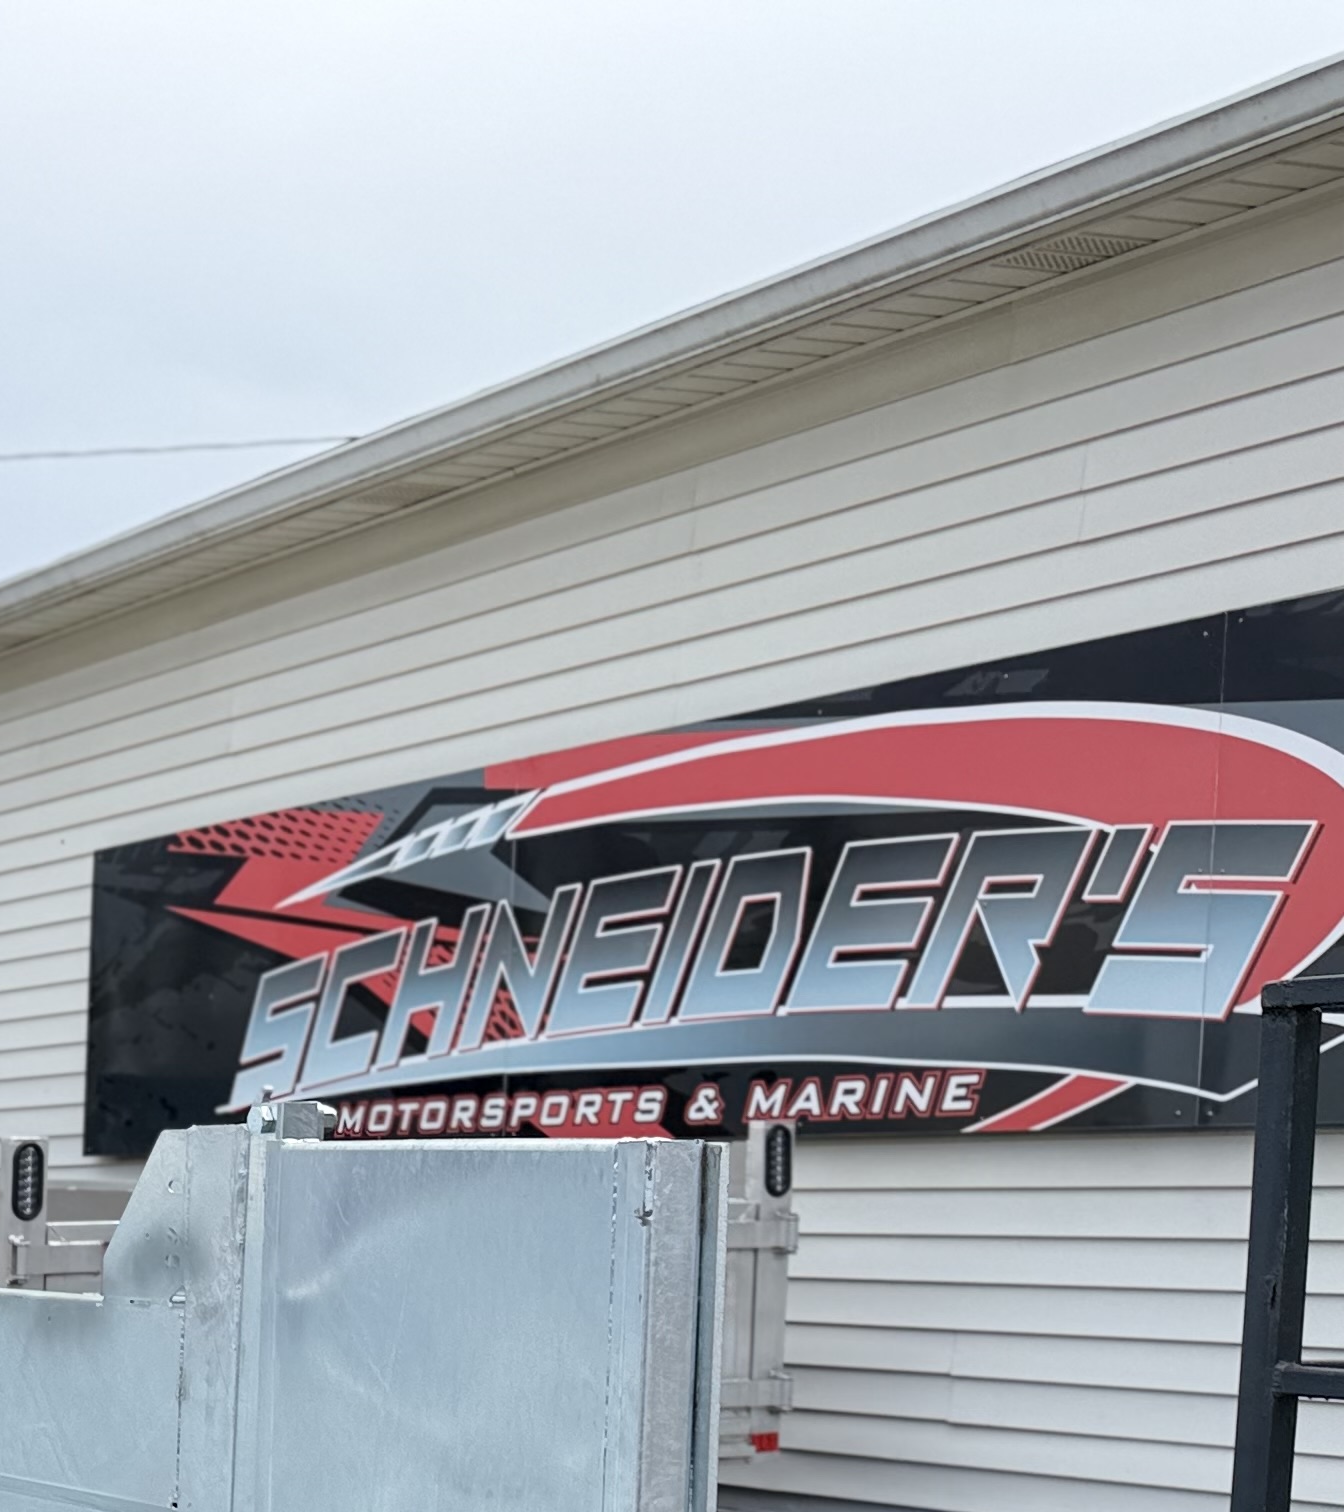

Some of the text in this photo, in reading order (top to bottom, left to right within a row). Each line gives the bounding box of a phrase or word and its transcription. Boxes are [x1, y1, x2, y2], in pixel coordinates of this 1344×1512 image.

[217, 820, 1316, 1113] SCHNEIDER'S
[333, 1069, 985, 1138] MOTORSPORTS & MARINE
